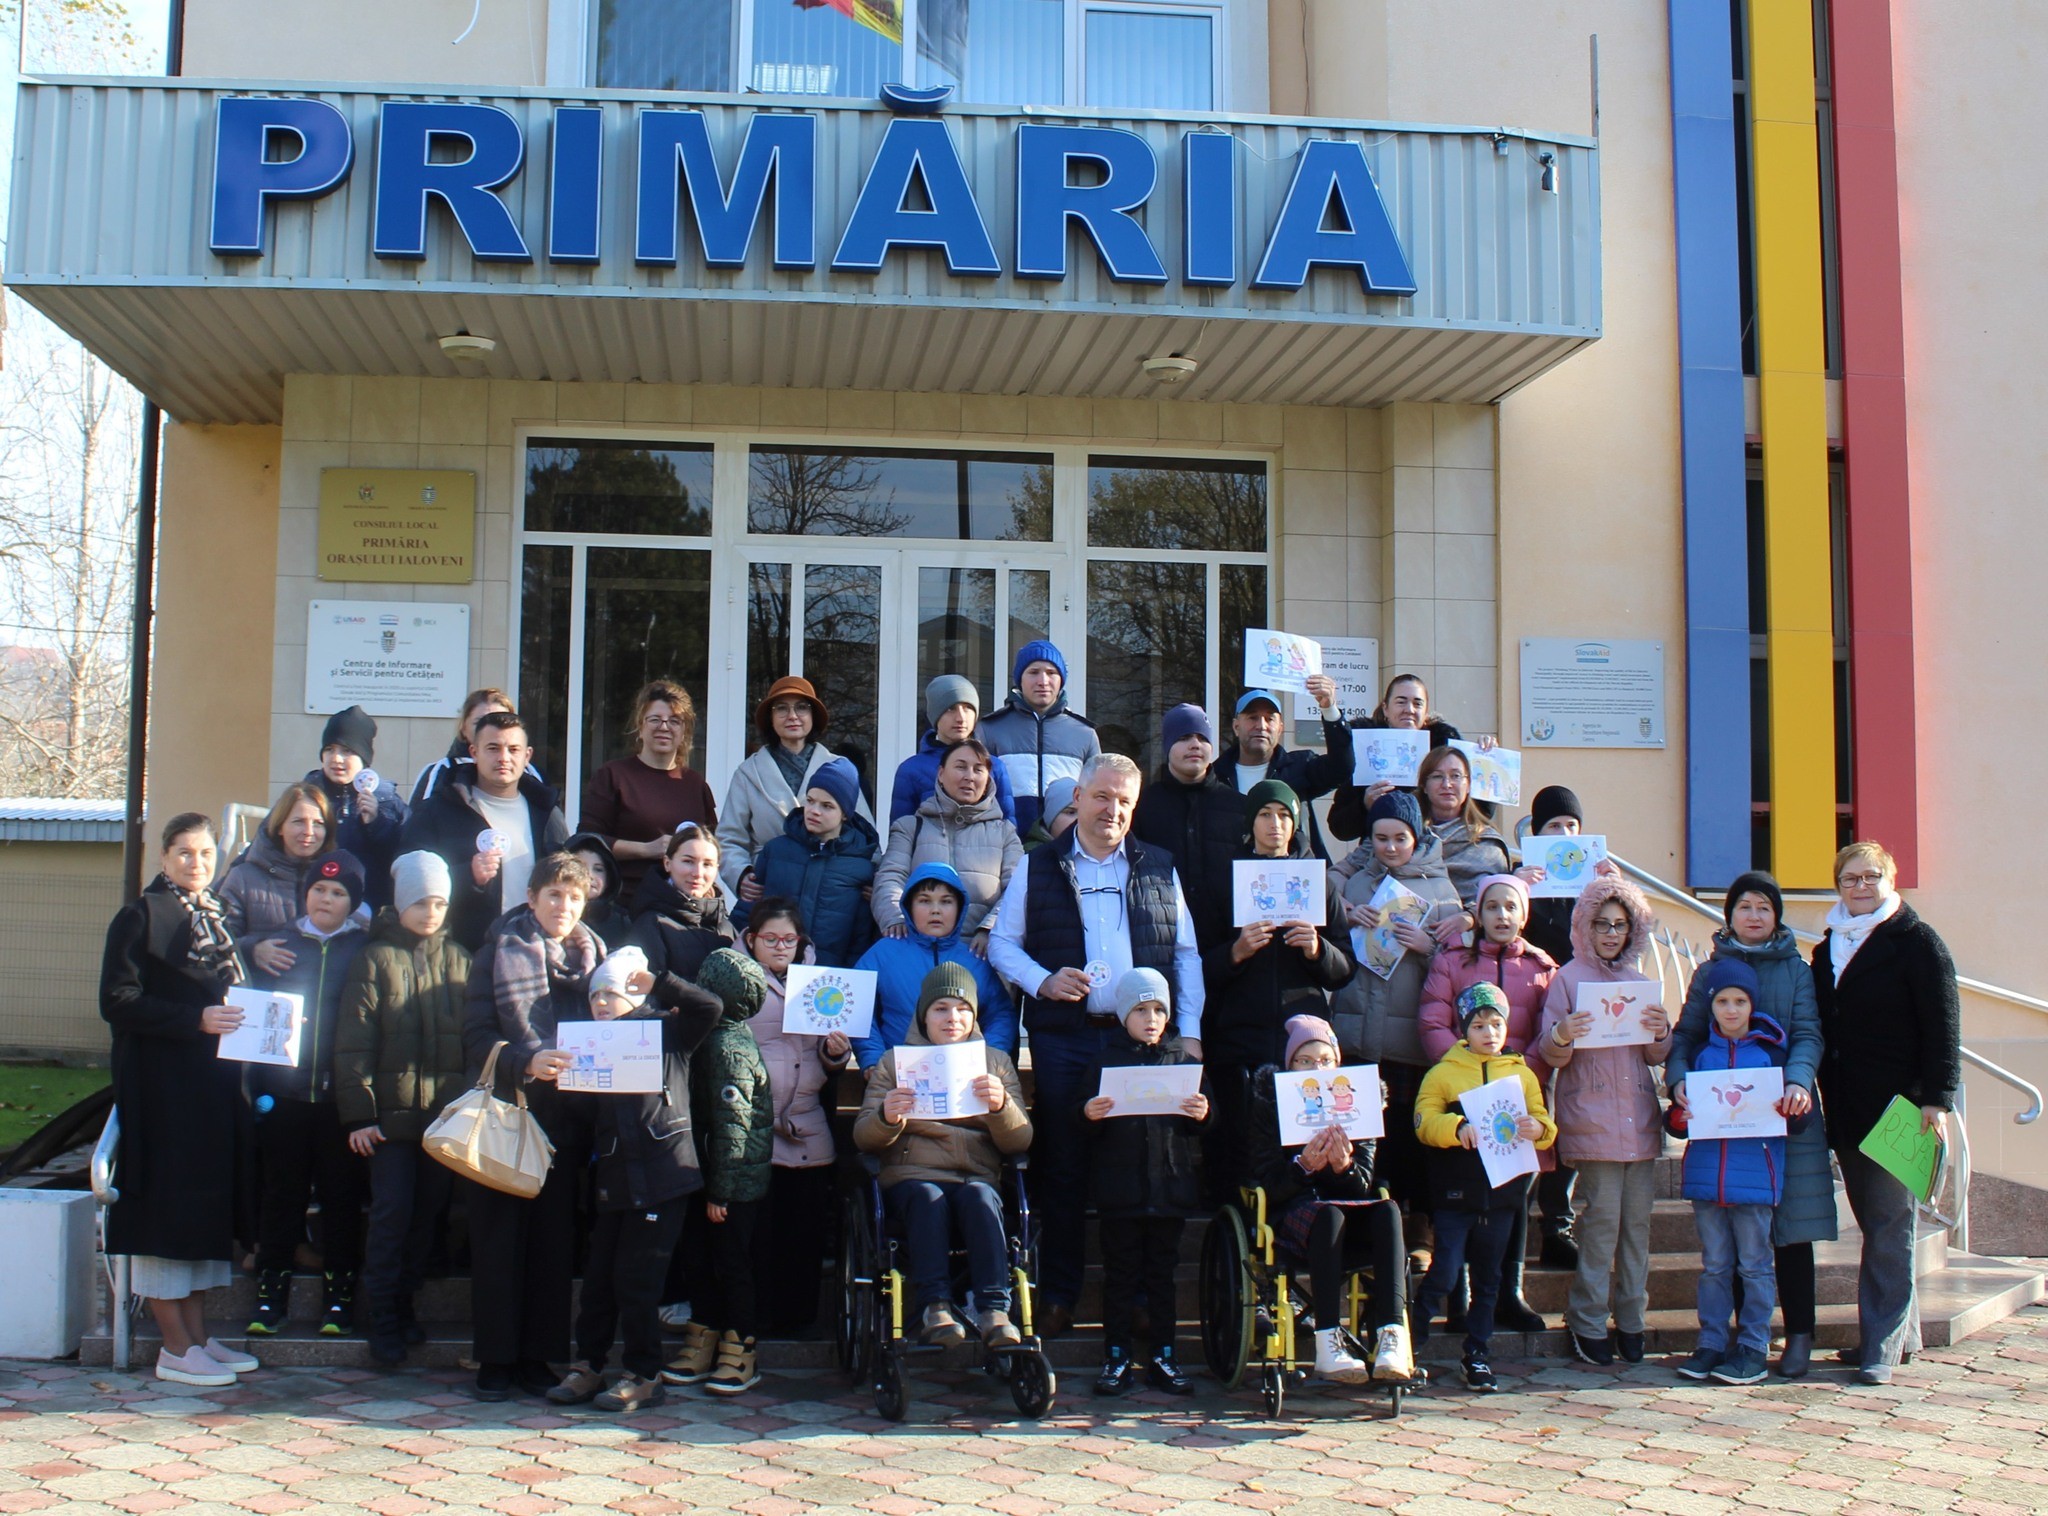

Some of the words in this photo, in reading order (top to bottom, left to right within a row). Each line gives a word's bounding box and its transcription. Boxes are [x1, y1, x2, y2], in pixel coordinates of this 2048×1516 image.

[209, 83, 1418, 297] PRIMĂRIA
[353, 520, 403, 530] CONSILIUL
[407, 521, 439, 530] LOCAL
[362, 537, 430, 549] PRIMĂRIA
[399, 554, 464, 567] IALOVENI
[343, 659, 373, 668] Centru
[375, 660, 386, 668] de
[388, 660, 432, 669] Informare
[1338, 661, 1348, 669] de
[1349, 662, 1369, 670] lucru
[339, 668, 372, 677] Servicii
[374, 669, 404, 678] pentru
[1342, 684, 1366, 693] 17:00
[1307, 706, 1321, 715] 13:
[1342, 707, 1366, 716] 14:00
